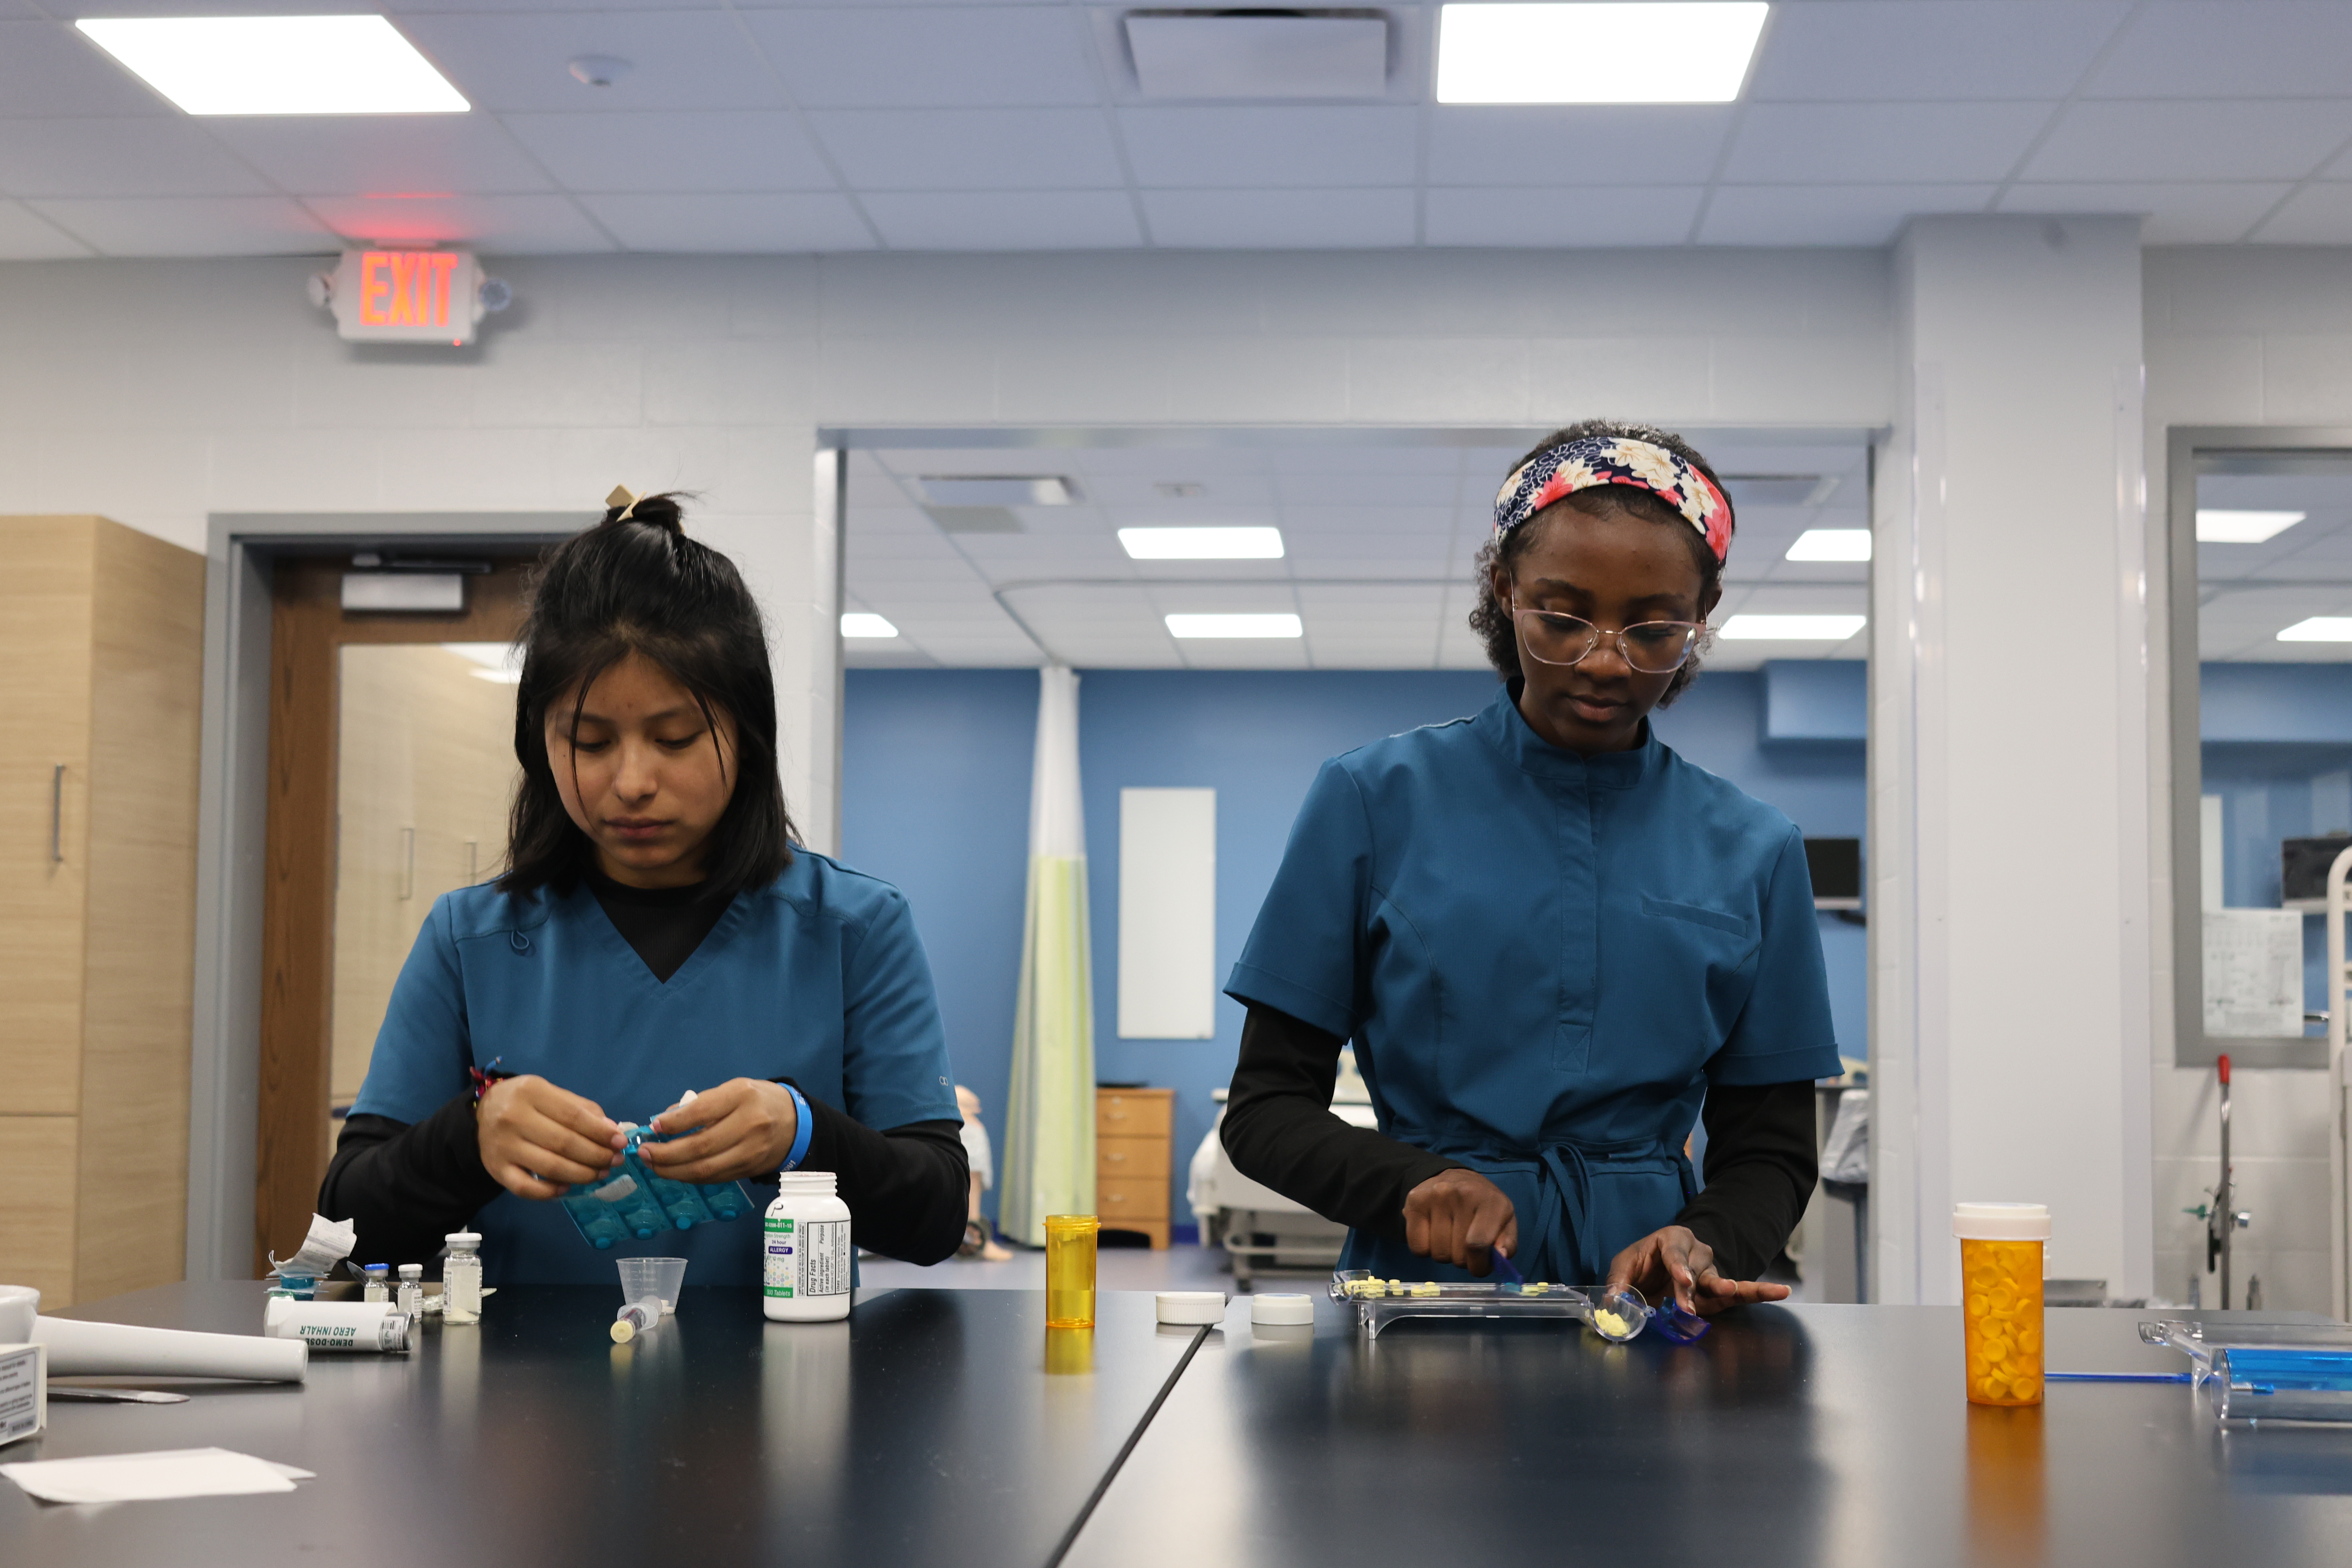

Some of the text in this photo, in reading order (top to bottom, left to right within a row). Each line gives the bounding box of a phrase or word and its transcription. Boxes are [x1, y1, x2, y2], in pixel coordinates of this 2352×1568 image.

[360, 252, 457, 327] EXIT
[300, 1325, 356, 1336] AERO INHALR
[305, 1338, 353, 1346] DEMO-DOSE
